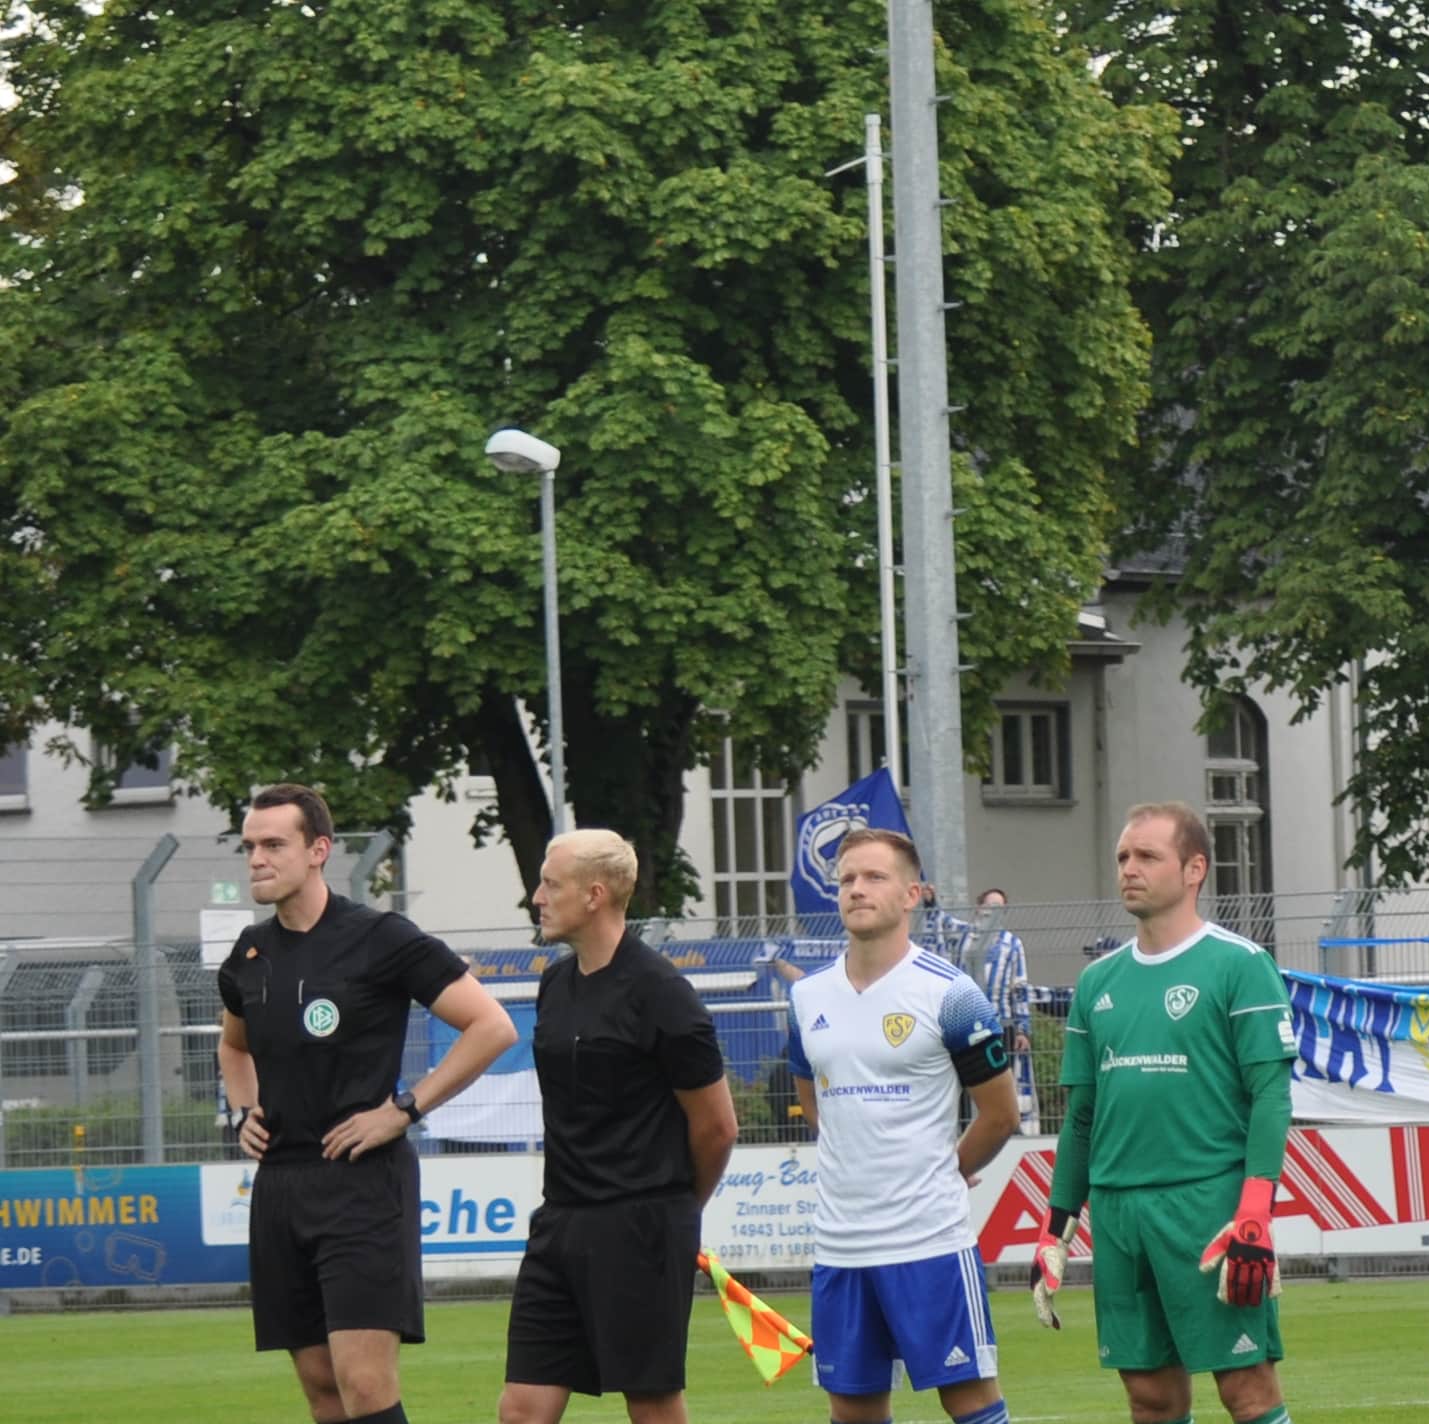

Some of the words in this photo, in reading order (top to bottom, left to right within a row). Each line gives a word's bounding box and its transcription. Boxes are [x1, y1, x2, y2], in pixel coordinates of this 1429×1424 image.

[1169, 987, 1194, 1010] FSV
[886, 1015, 912, 1037] FSV
[985, 1039, 1009, 1069] C
[1110, 1054, 1187, 1068] UCKENWALDER
[829, 1084, 910, 1097] UCKENWALDER
[736, 1201, 792, 1216] Zinnaer
